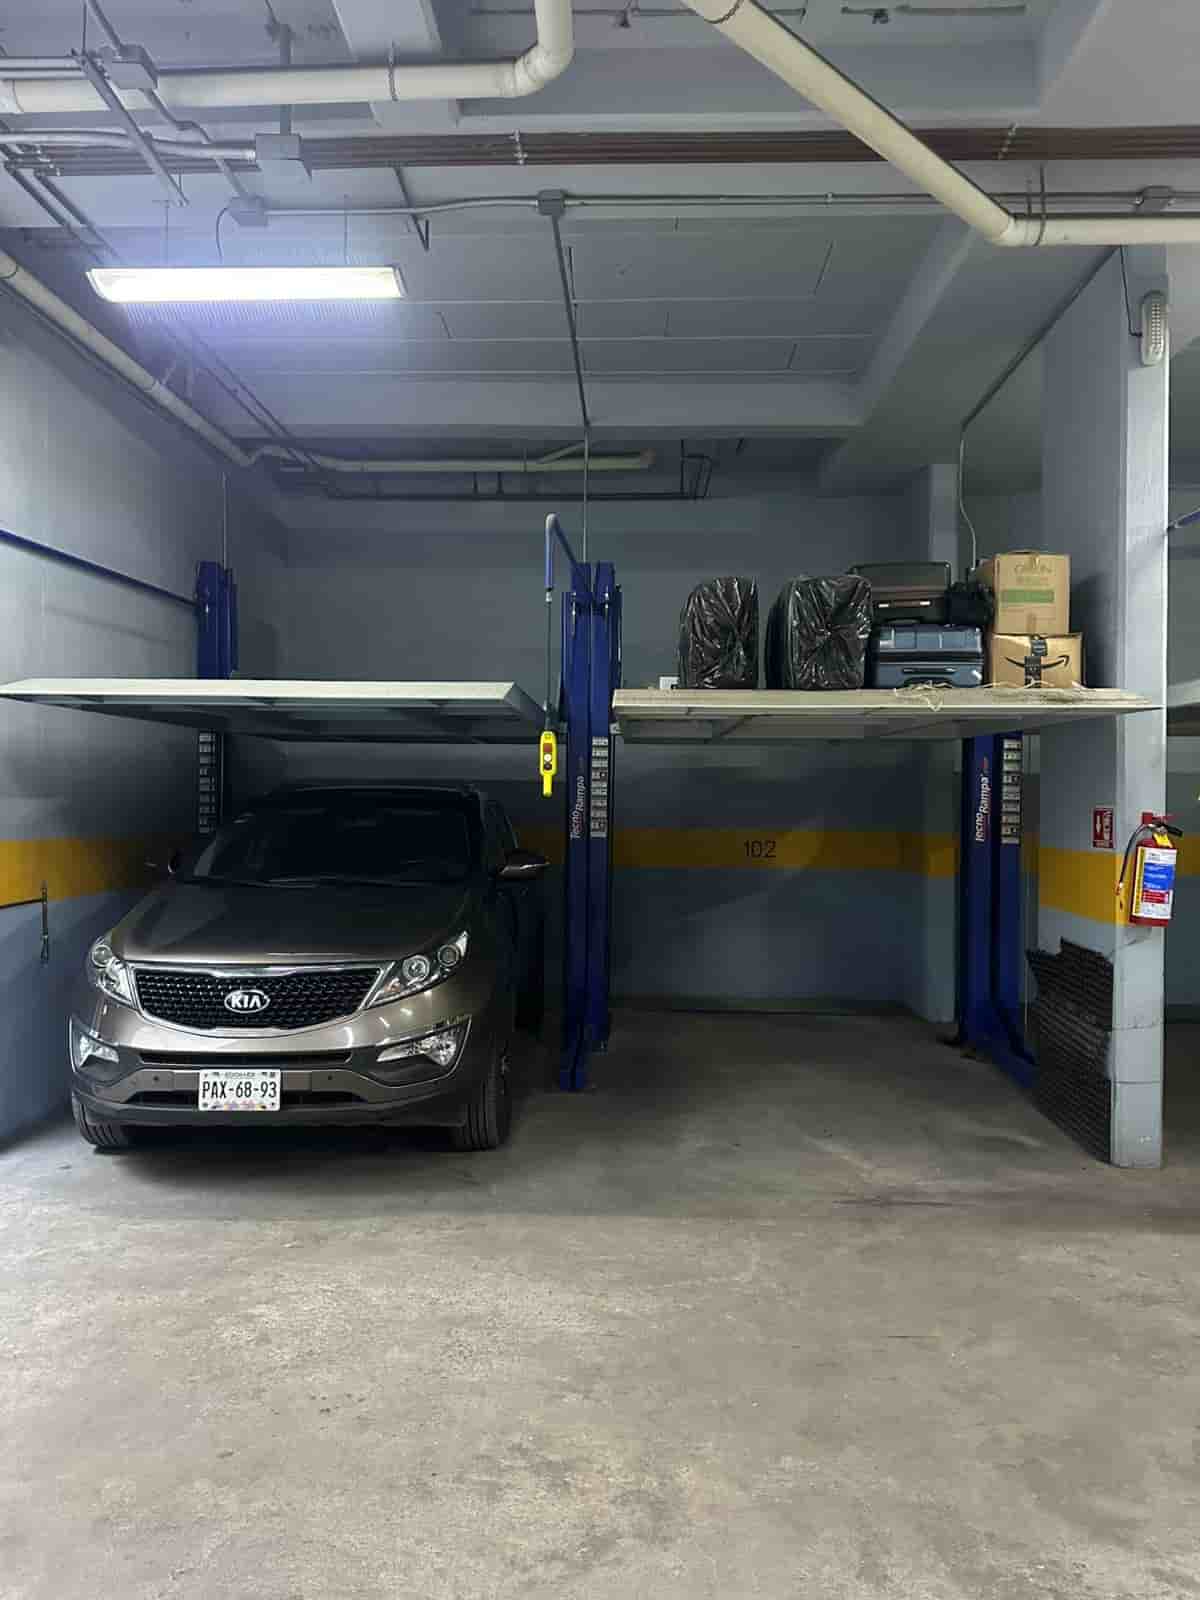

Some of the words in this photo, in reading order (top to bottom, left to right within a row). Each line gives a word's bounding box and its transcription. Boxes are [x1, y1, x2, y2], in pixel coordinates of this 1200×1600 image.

[743, 840, 777, 858] 102
[231, 994, 261, 1009] KIA
[202, 1081, 277, 1099] PAX-68-93
